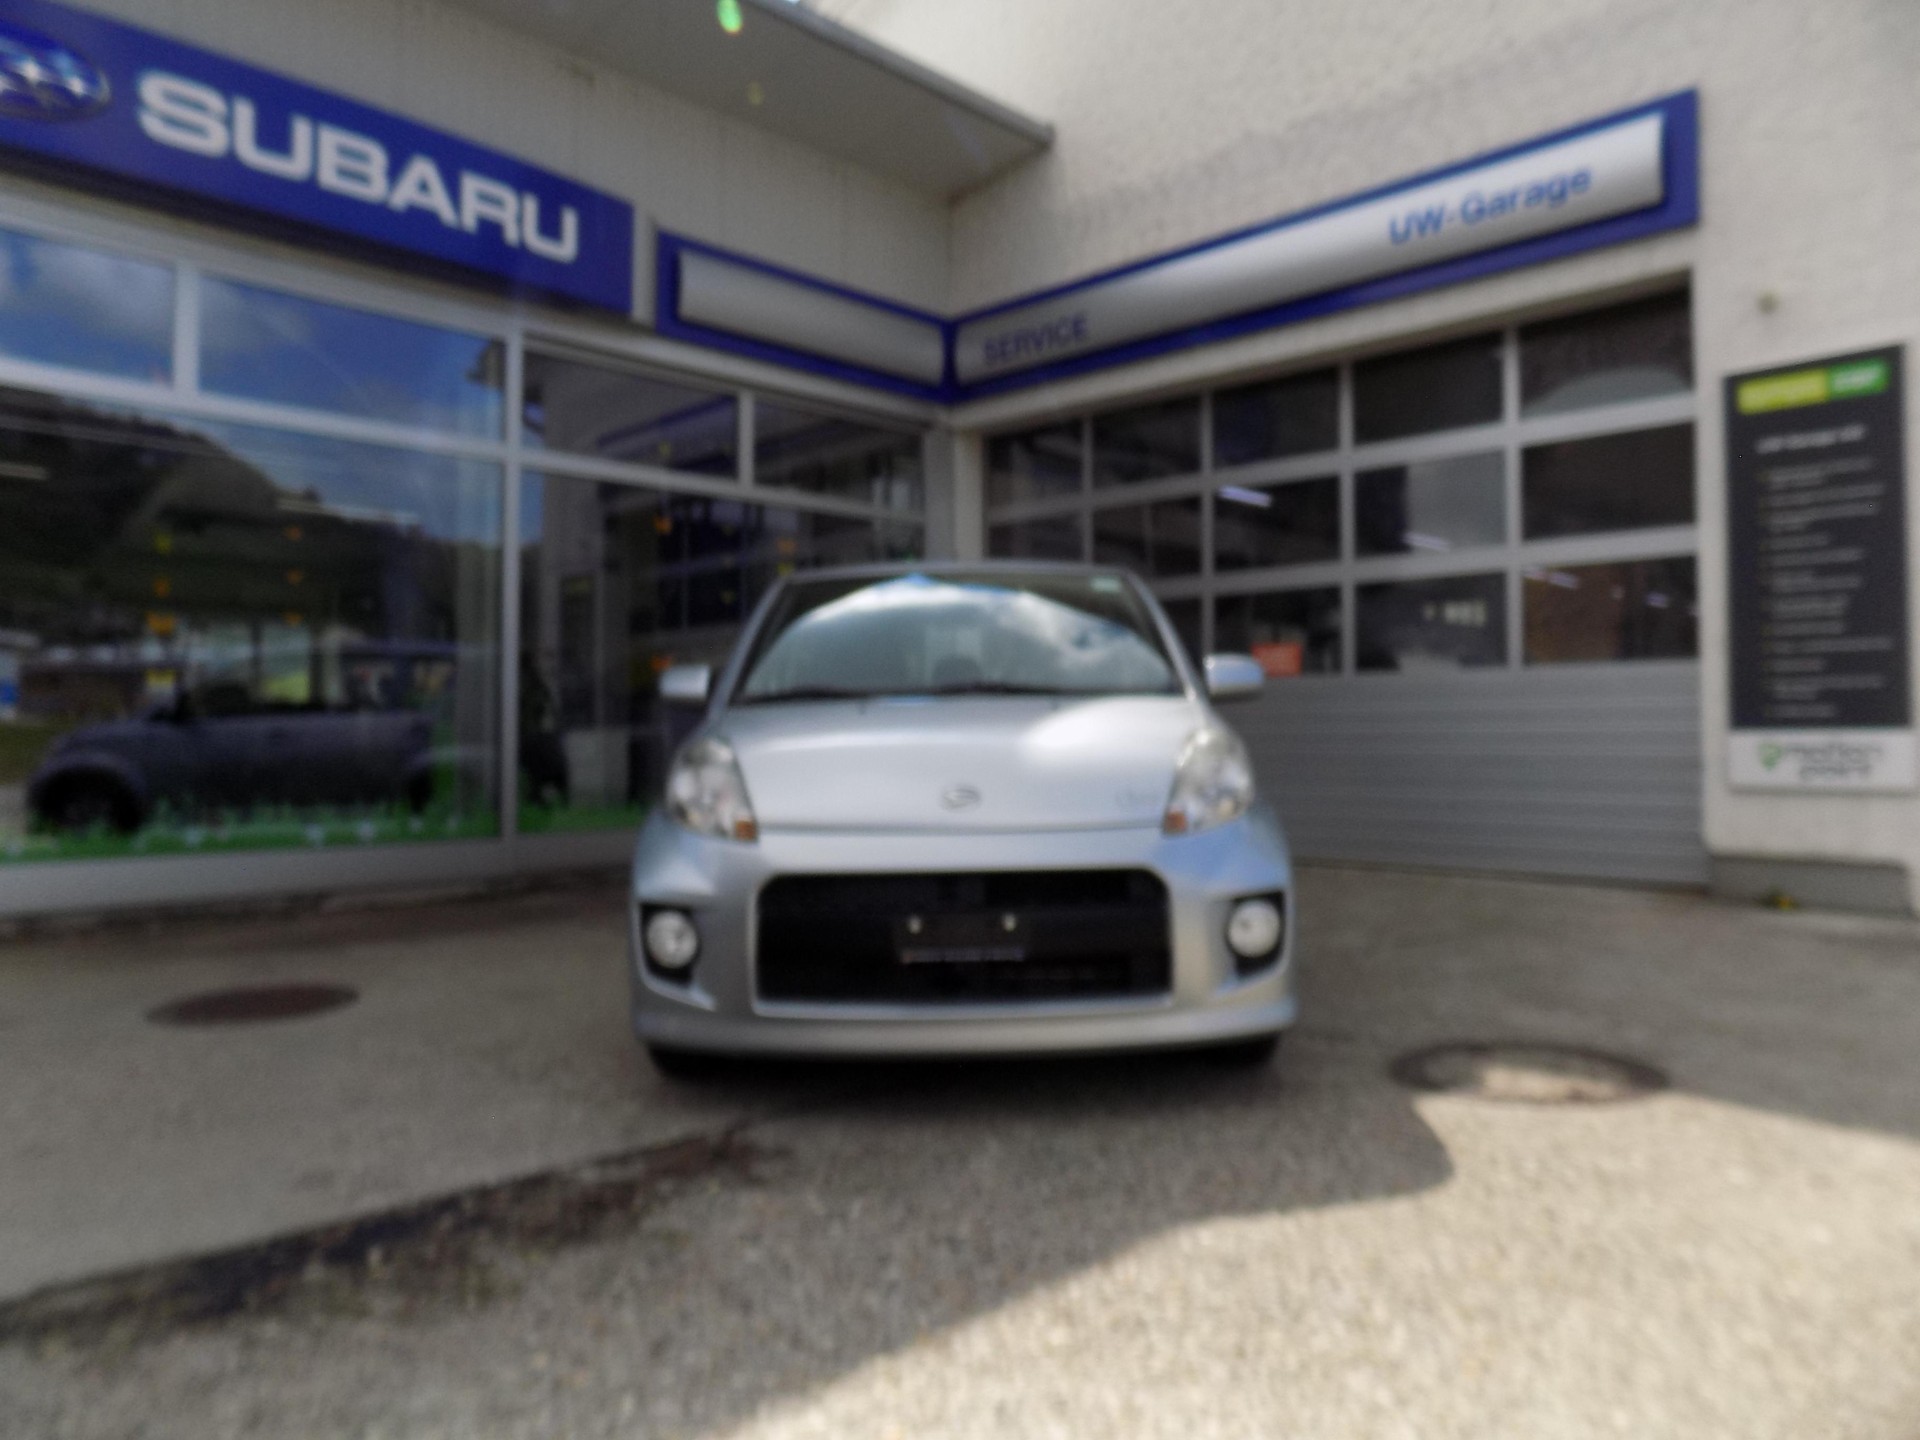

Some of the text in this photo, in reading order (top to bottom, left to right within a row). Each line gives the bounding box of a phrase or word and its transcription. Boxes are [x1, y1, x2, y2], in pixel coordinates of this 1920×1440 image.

[138, 70, 579, 263] SUBARU
[1389, 168, 1592, 244] UW-Garage
[984, 314, 1088, 362] SERVICE
